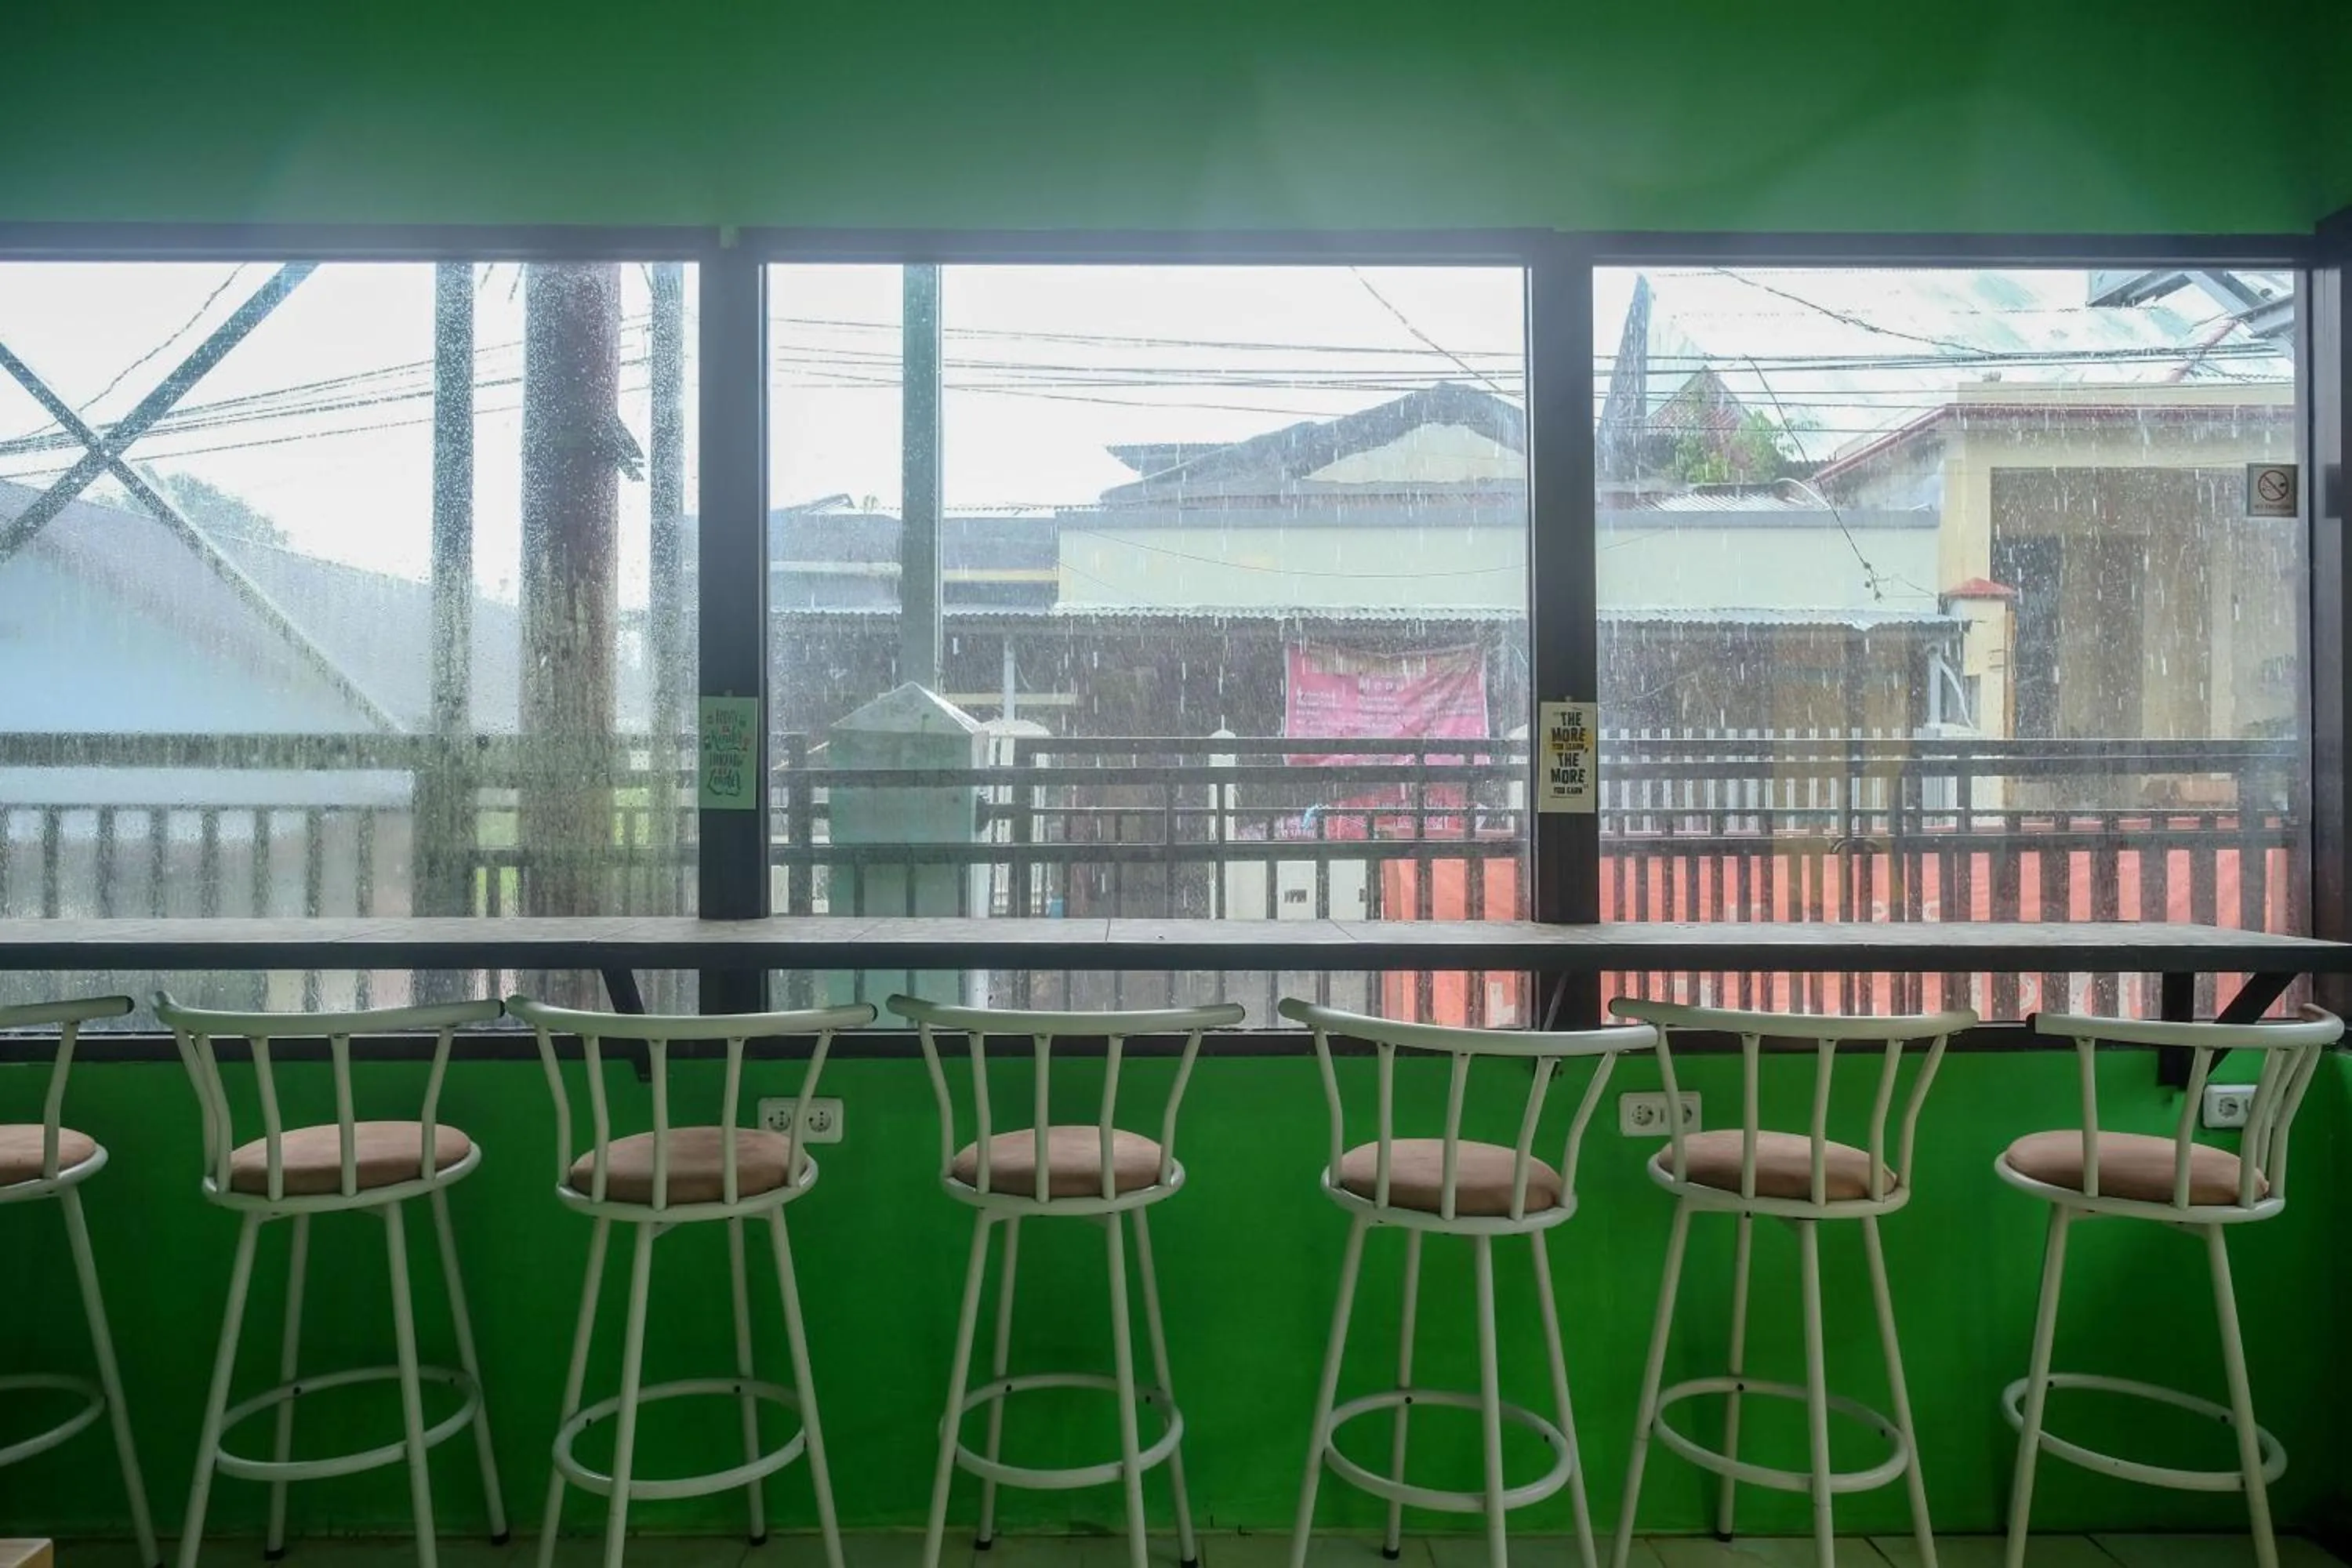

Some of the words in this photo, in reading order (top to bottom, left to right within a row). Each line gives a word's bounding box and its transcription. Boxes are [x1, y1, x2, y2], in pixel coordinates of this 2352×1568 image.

[1551, 728, 1586, 742] MORE
[1557, 753, 1580, 767] THE
[1551, 768, 1586, 784] MORE
